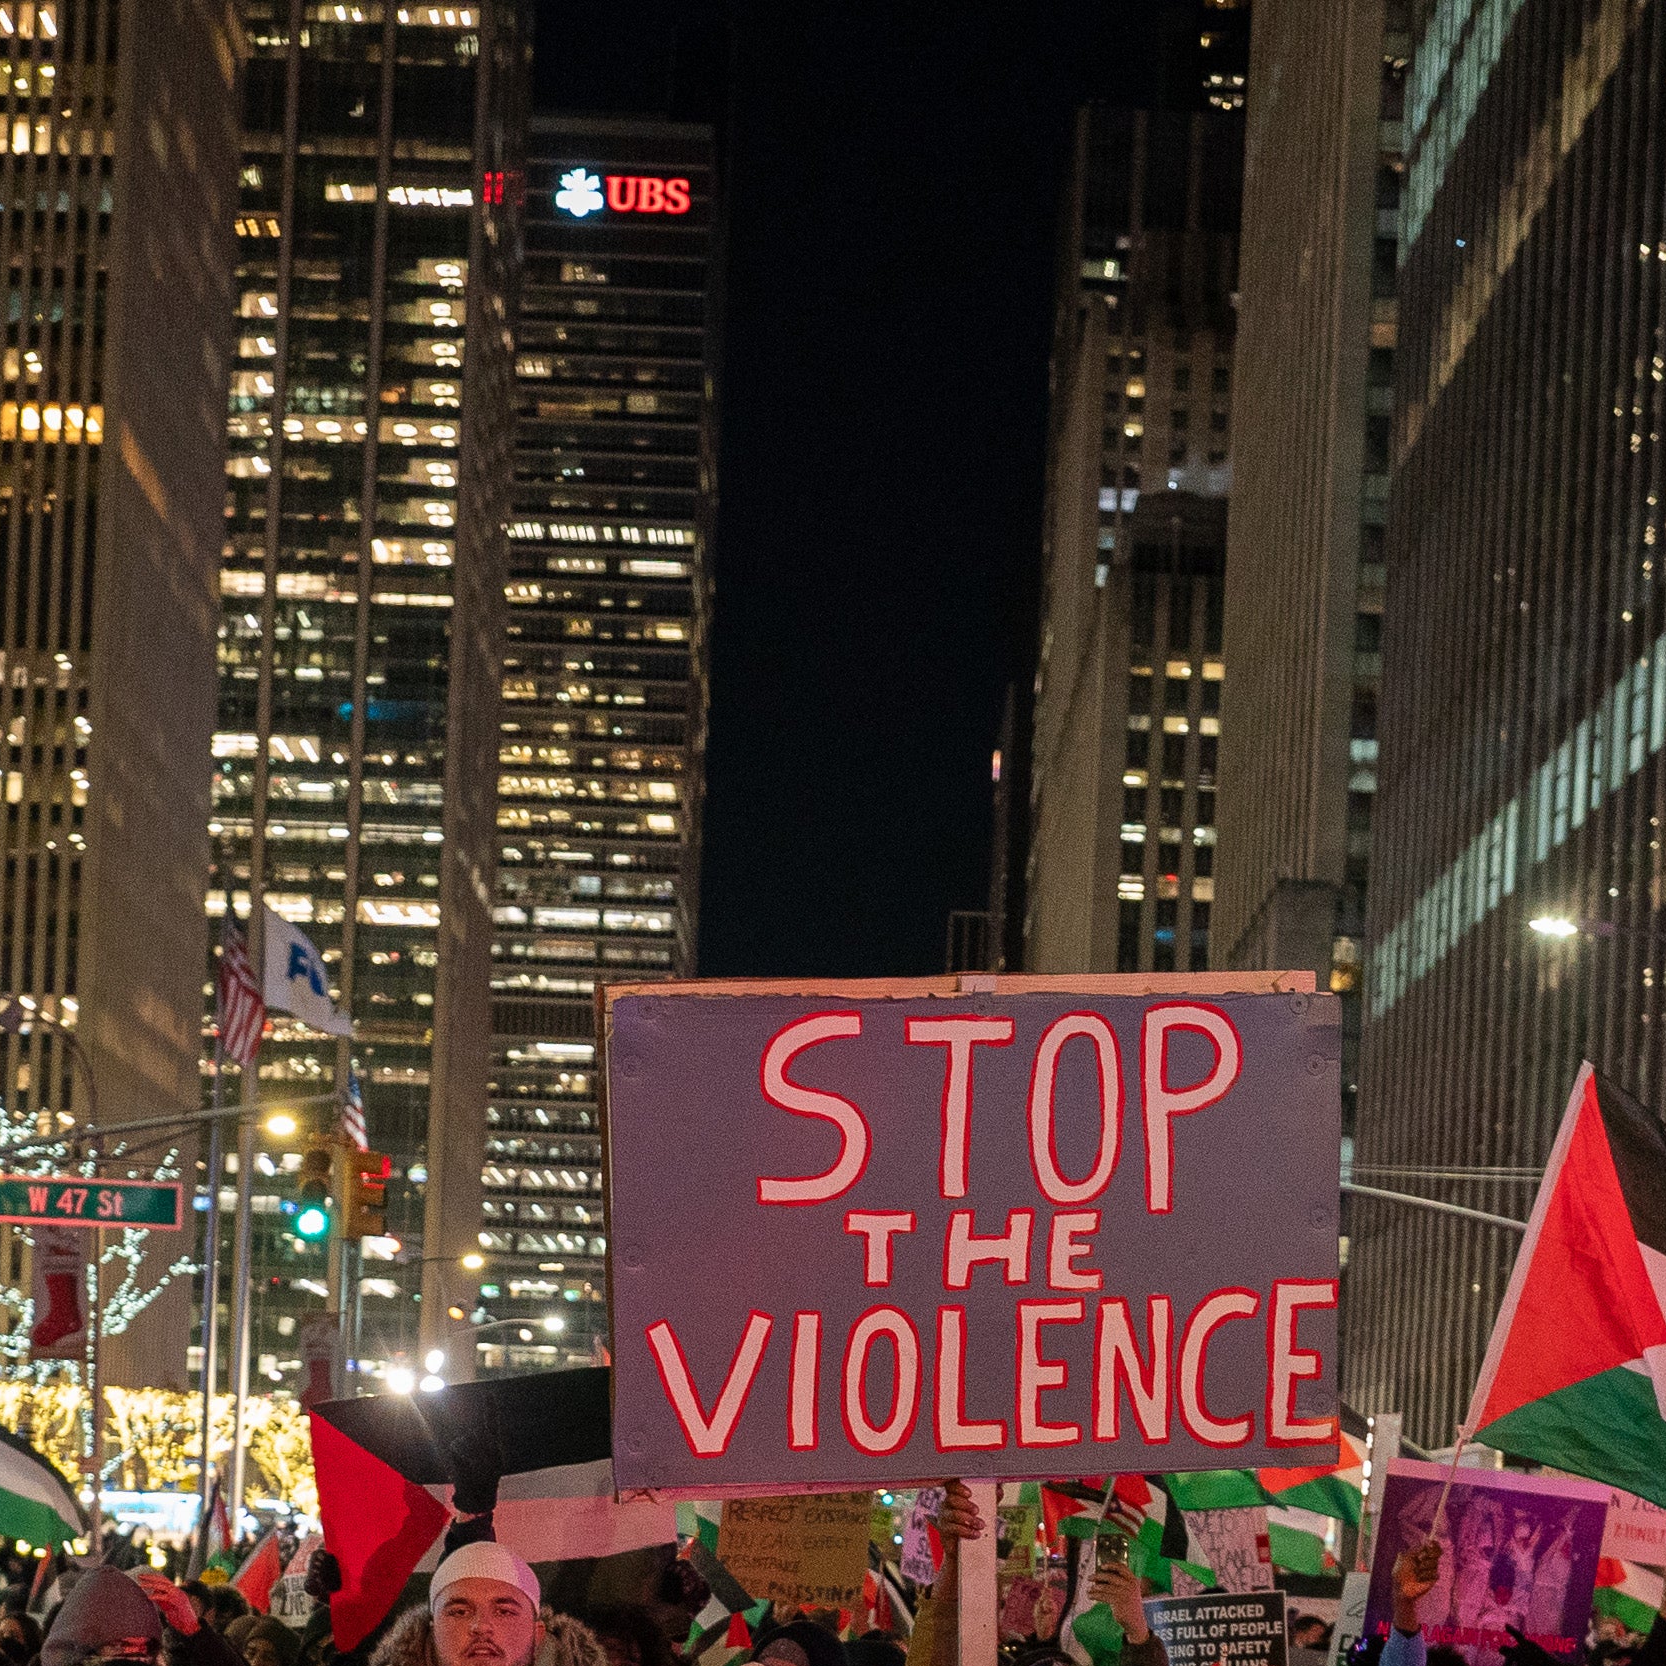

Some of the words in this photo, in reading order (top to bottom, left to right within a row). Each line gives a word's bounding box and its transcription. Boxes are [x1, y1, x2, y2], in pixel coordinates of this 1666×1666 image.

[605, 175, 691, 215] UBS
[756, 1000, 1243, 1214] STOP
[27, 1186, 49, 1213] W
[56, 1188, 89, 1214] 47
[97, 1190, 124, 1217] St
[844, 1208, 1103, 1290] THE
[646, 1278, 1339, 1458] VIOLENCE
[1153, 1608, 1193, 1625] ISRAEL
[1195, 1603, 1266, 1621] ATTACKED
[1176, 1625, 1208, 1640] FULL
[1209, 1623, 1228, 1638] OF
[1230, 1620, 1284, 1636] PEOPLE
[1167, 1644, 1196, 1659] EING
[1198, 1642, 1216, 1657] TO
[1219, 1639, 1273, 1657] SAFETY
